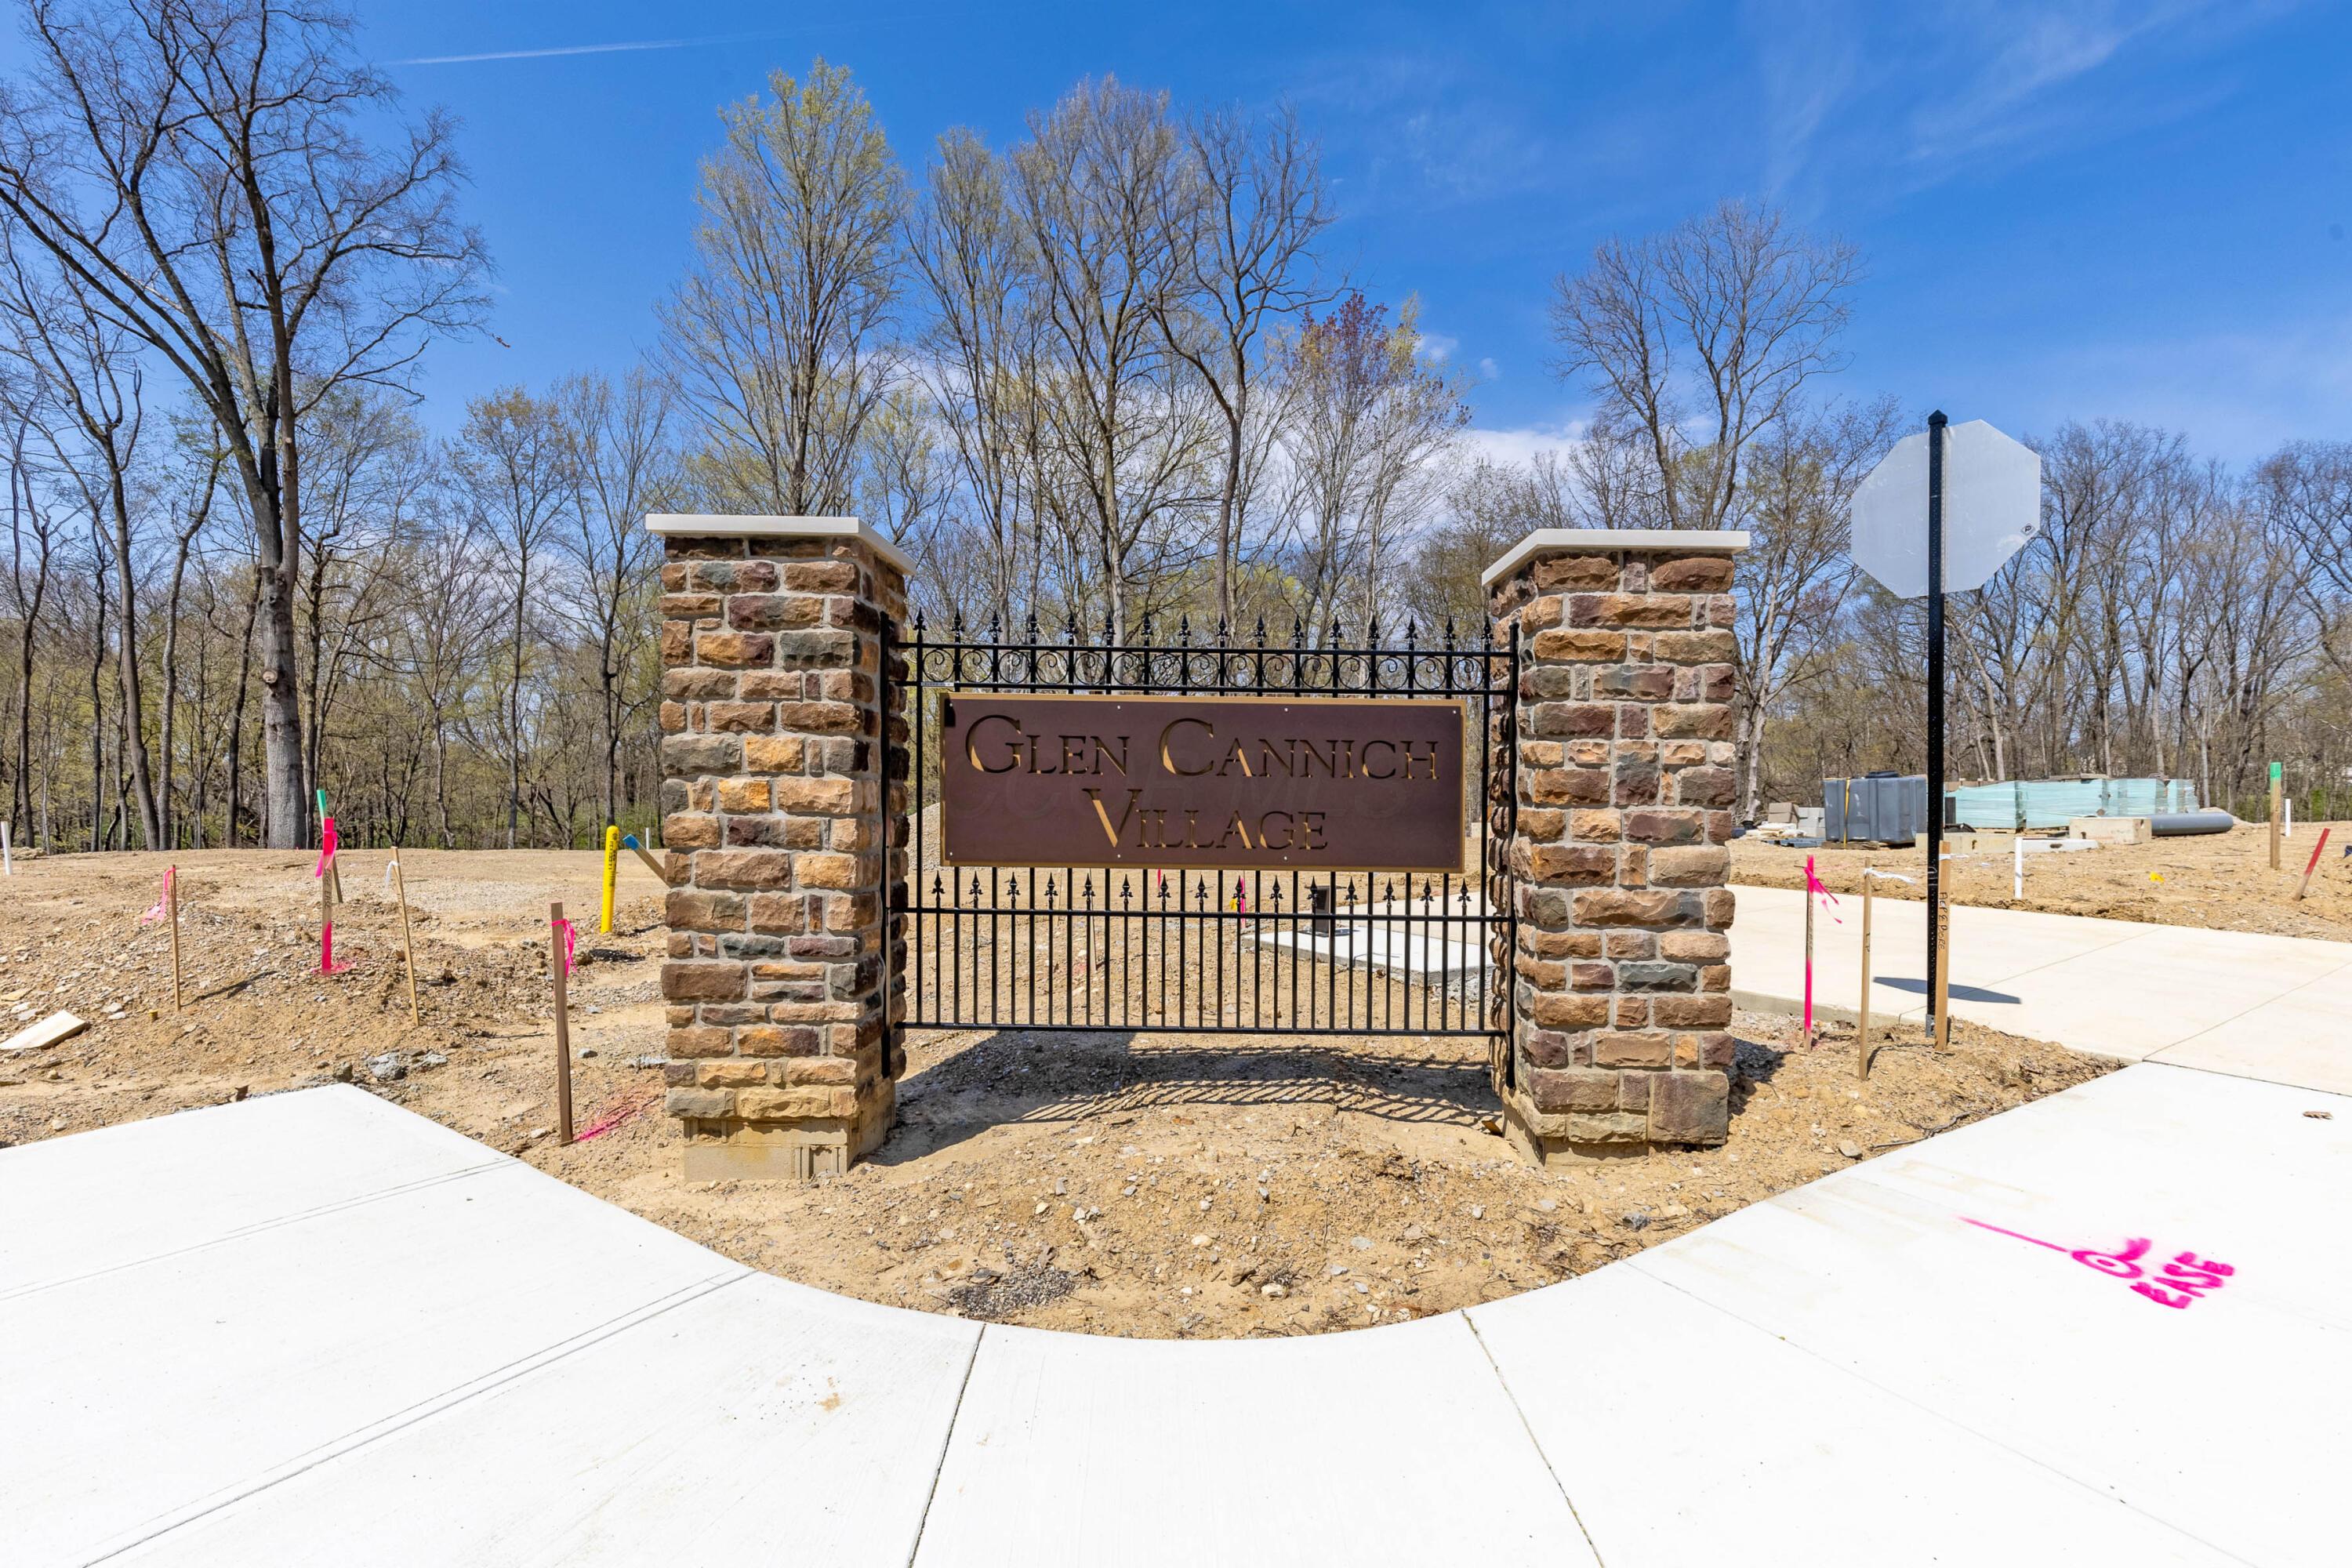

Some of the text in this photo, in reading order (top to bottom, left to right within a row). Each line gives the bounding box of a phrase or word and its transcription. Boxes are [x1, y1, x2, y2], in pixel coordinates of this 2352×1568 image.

[965, 714, 1439, 781] GLEN CANNICH
[1083, 788, 1328, 851] VILLAGE
[2129, 1251, 2235, 1309] EASE
